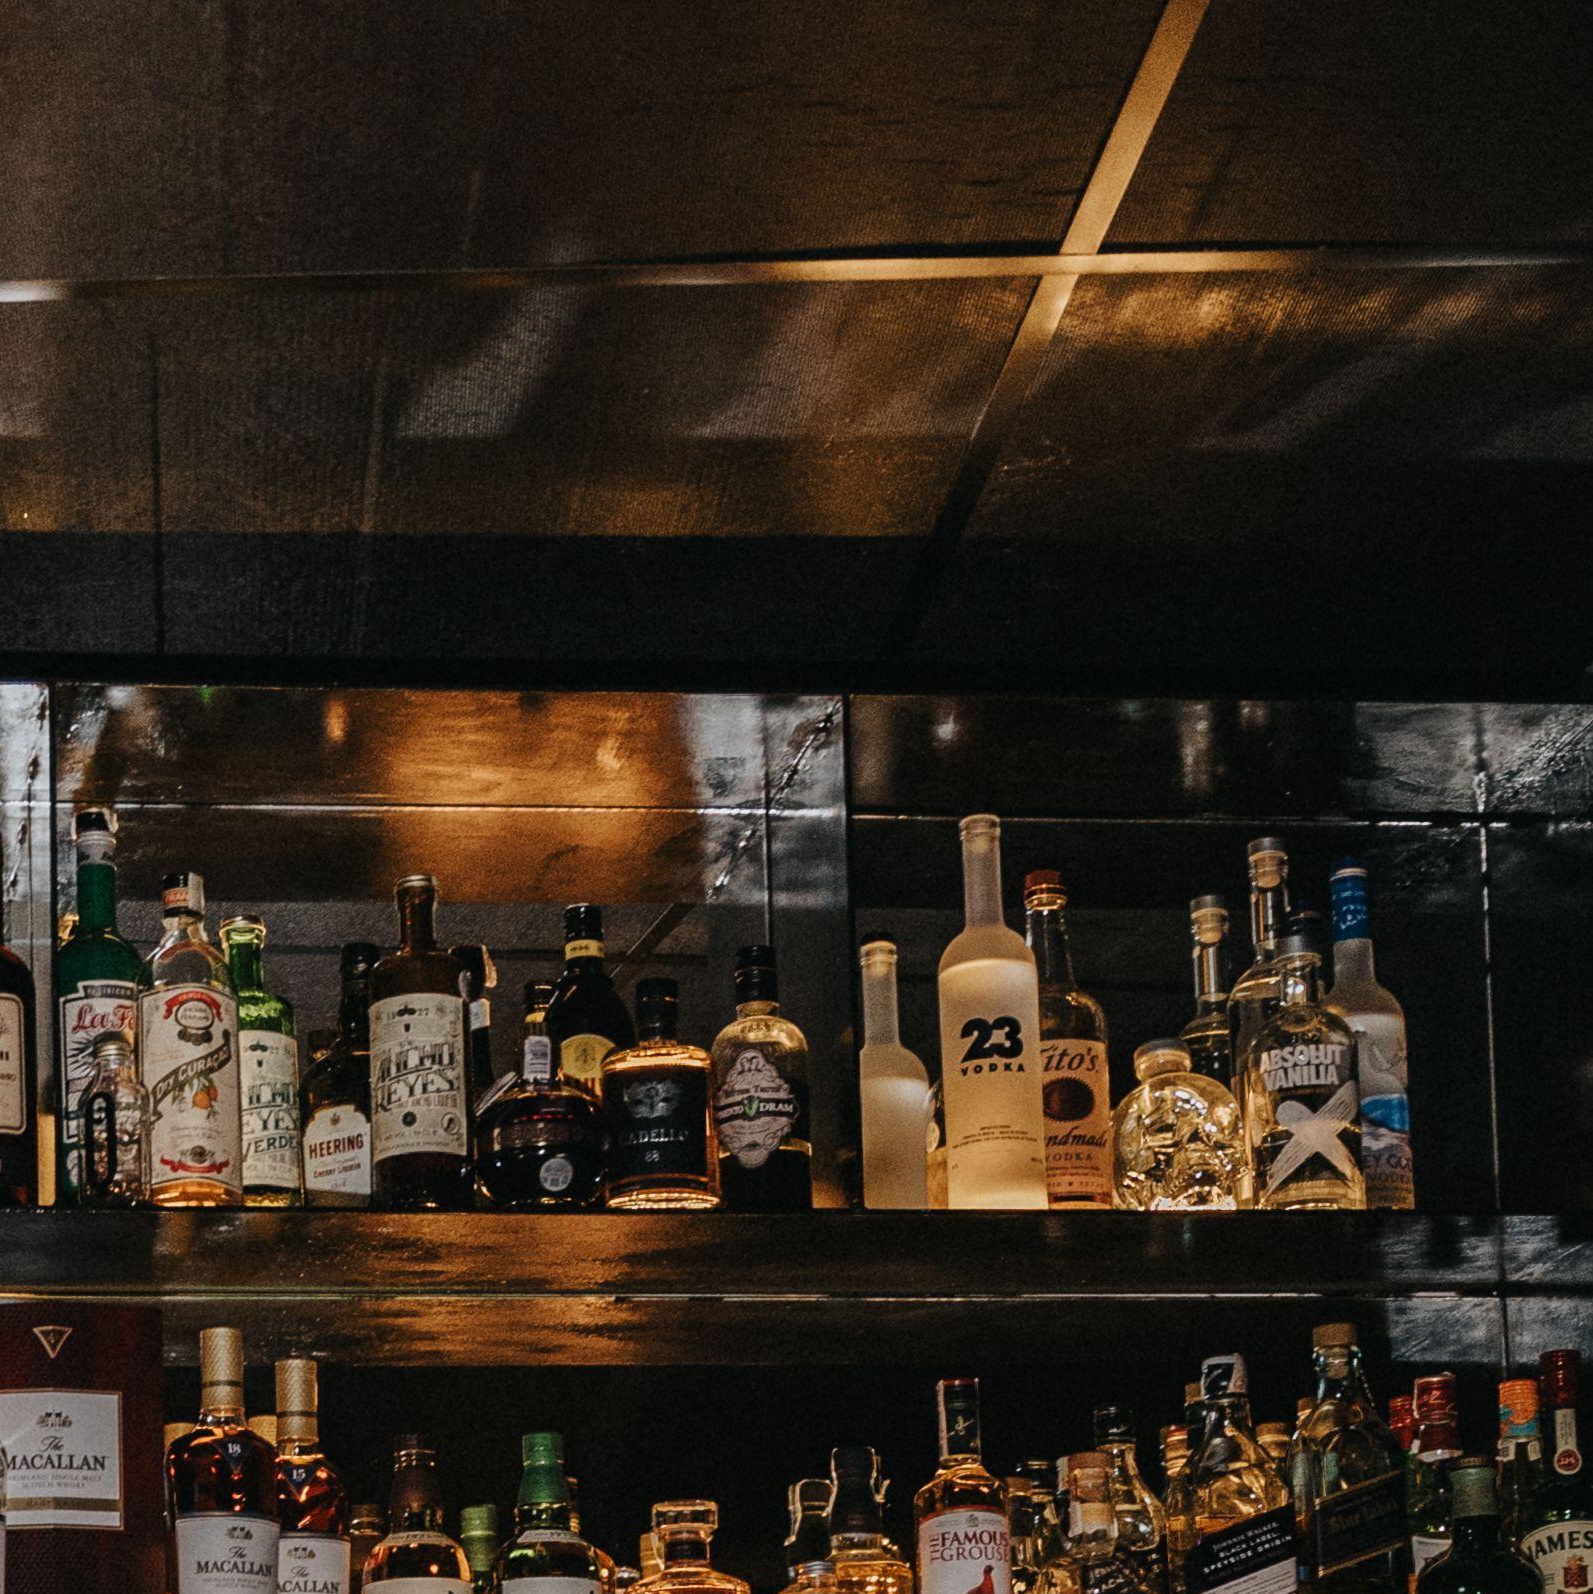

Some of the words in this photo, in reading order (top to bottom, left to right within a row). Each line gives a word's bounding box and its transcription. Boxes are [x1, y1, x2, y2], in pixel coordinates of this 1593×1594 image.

[71, 1002, 107, 1032] La
[960, 1017, 1024, 1063] 23
[1260, 1043, 1345, 1068] ABSOLUT
[960, 1062, 1026, 1077] VODKA
[758, 1103, 794, 1113] DRAM
[308, 1133, 365, 1160] HEERING
[41, 1435, 64, 1453] The
[227, 1441, 242, 1456] 18
[6, 1453, 107, 1471] MACALLAN
[291, 1467, 307, 1482] 15
[929, 1532, 940, 1564] THE
[940, 1530, 1011, 1548] FAMOUS
[1218, 1542, 1248, 1559] BLACK
[1249, 1531, 1281, 1547] LABEL
[1523, 1530, 1593, 1561] JAMES
[1203, 1549, 1255, 1575] SPEYSIDE
[1256, 1535, 1294, 1554] ORIGIN
[196, 1560, 274, 1578] MACALLAN
